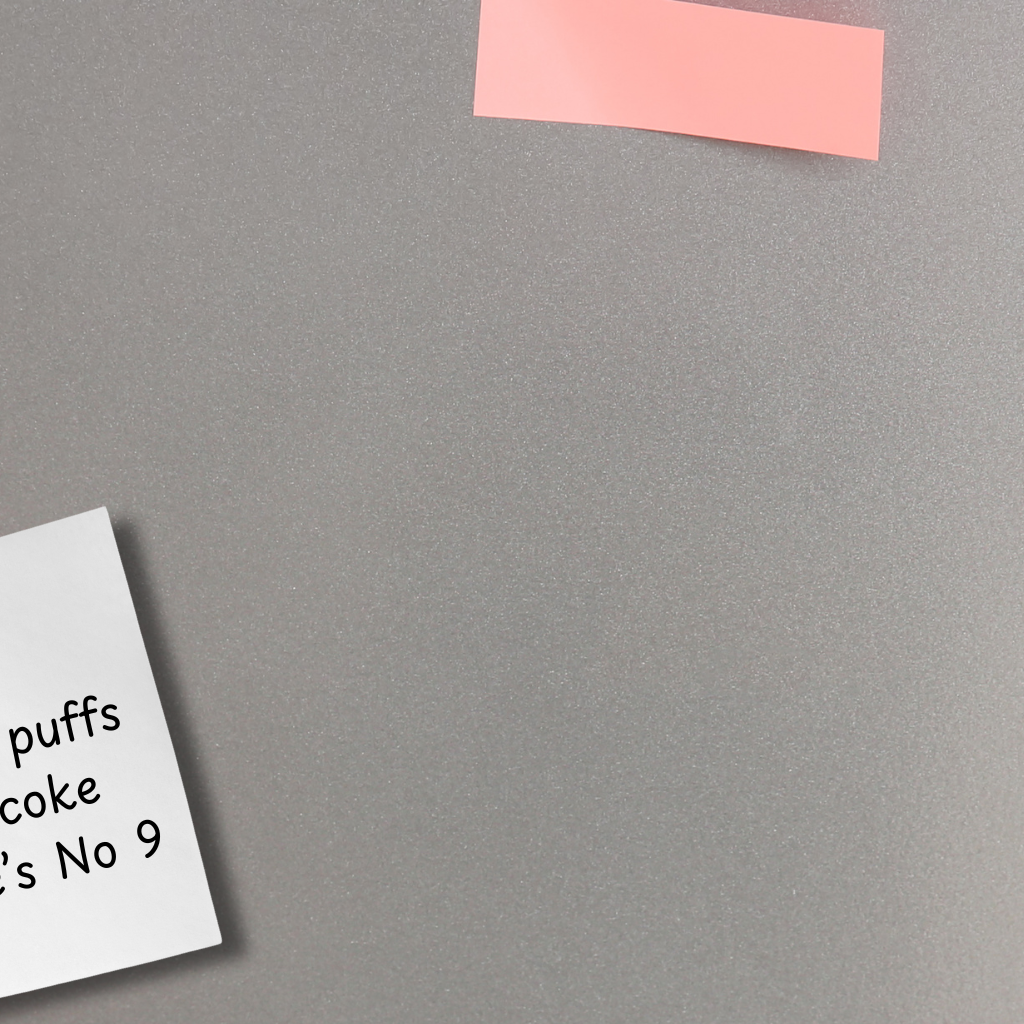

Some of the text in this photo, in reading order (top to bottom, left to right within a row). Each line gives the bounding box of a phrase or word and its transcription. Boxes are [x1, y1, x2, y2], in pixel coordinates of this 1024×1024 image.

[8, 694, 121, 769] puffs
[0, 773, 101, 825] coke
[55, 836, 117, 880] No
[136, 819, 161, 859] 9
